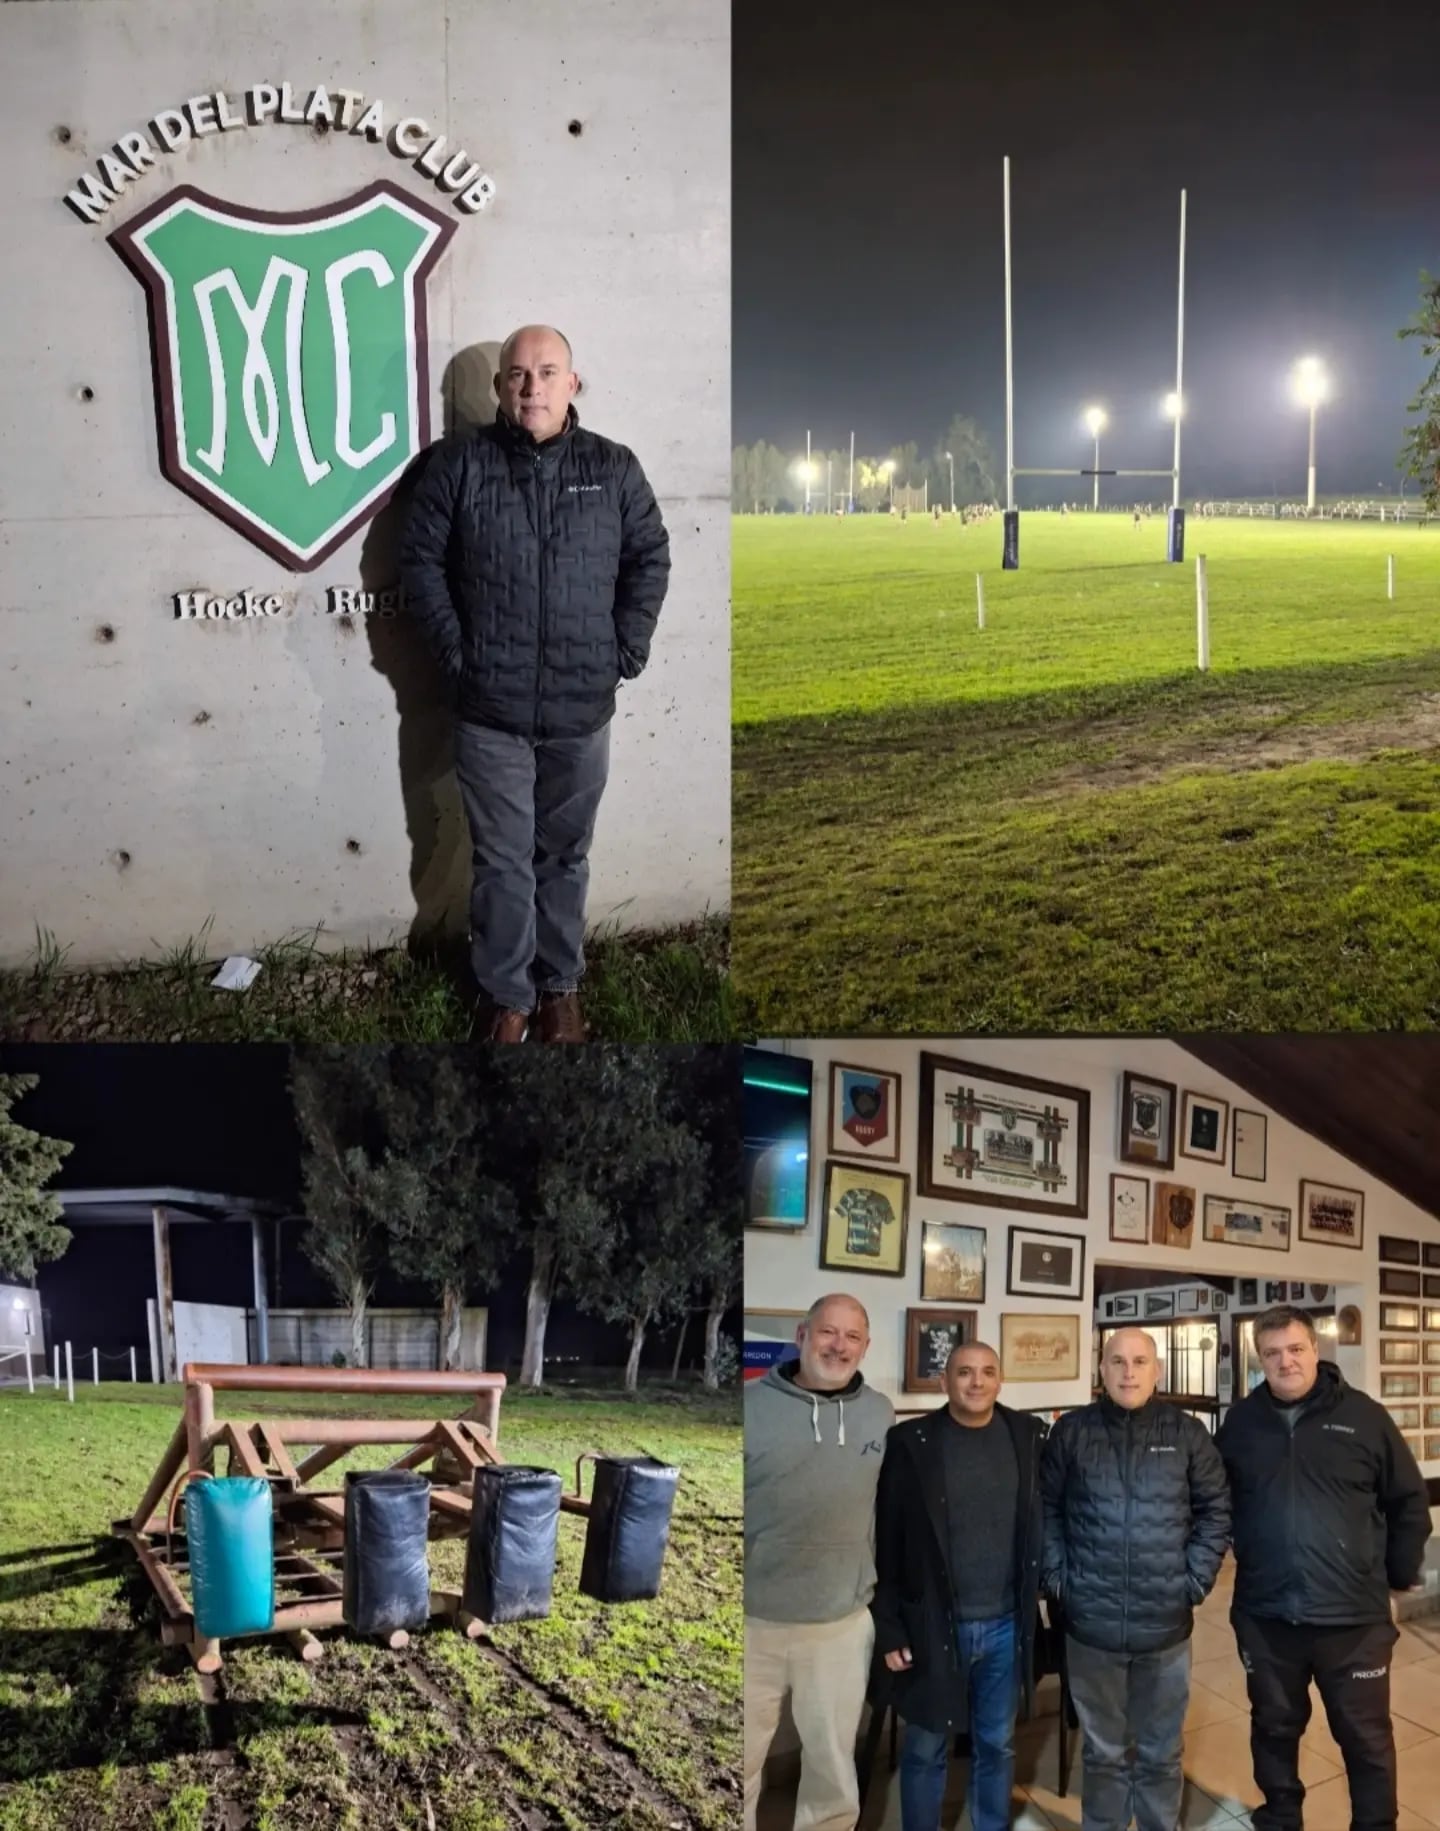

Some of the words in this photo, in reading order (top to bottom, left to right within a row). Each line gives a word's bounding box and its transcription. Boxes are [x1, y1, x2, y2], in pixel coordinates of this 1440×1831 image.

[66, 131, 155, 223] MAR
[151, 90, 245, 152] DEL
[250, 81, 385, 139] PLATA
[392, 117, 497, 214] CLUB
